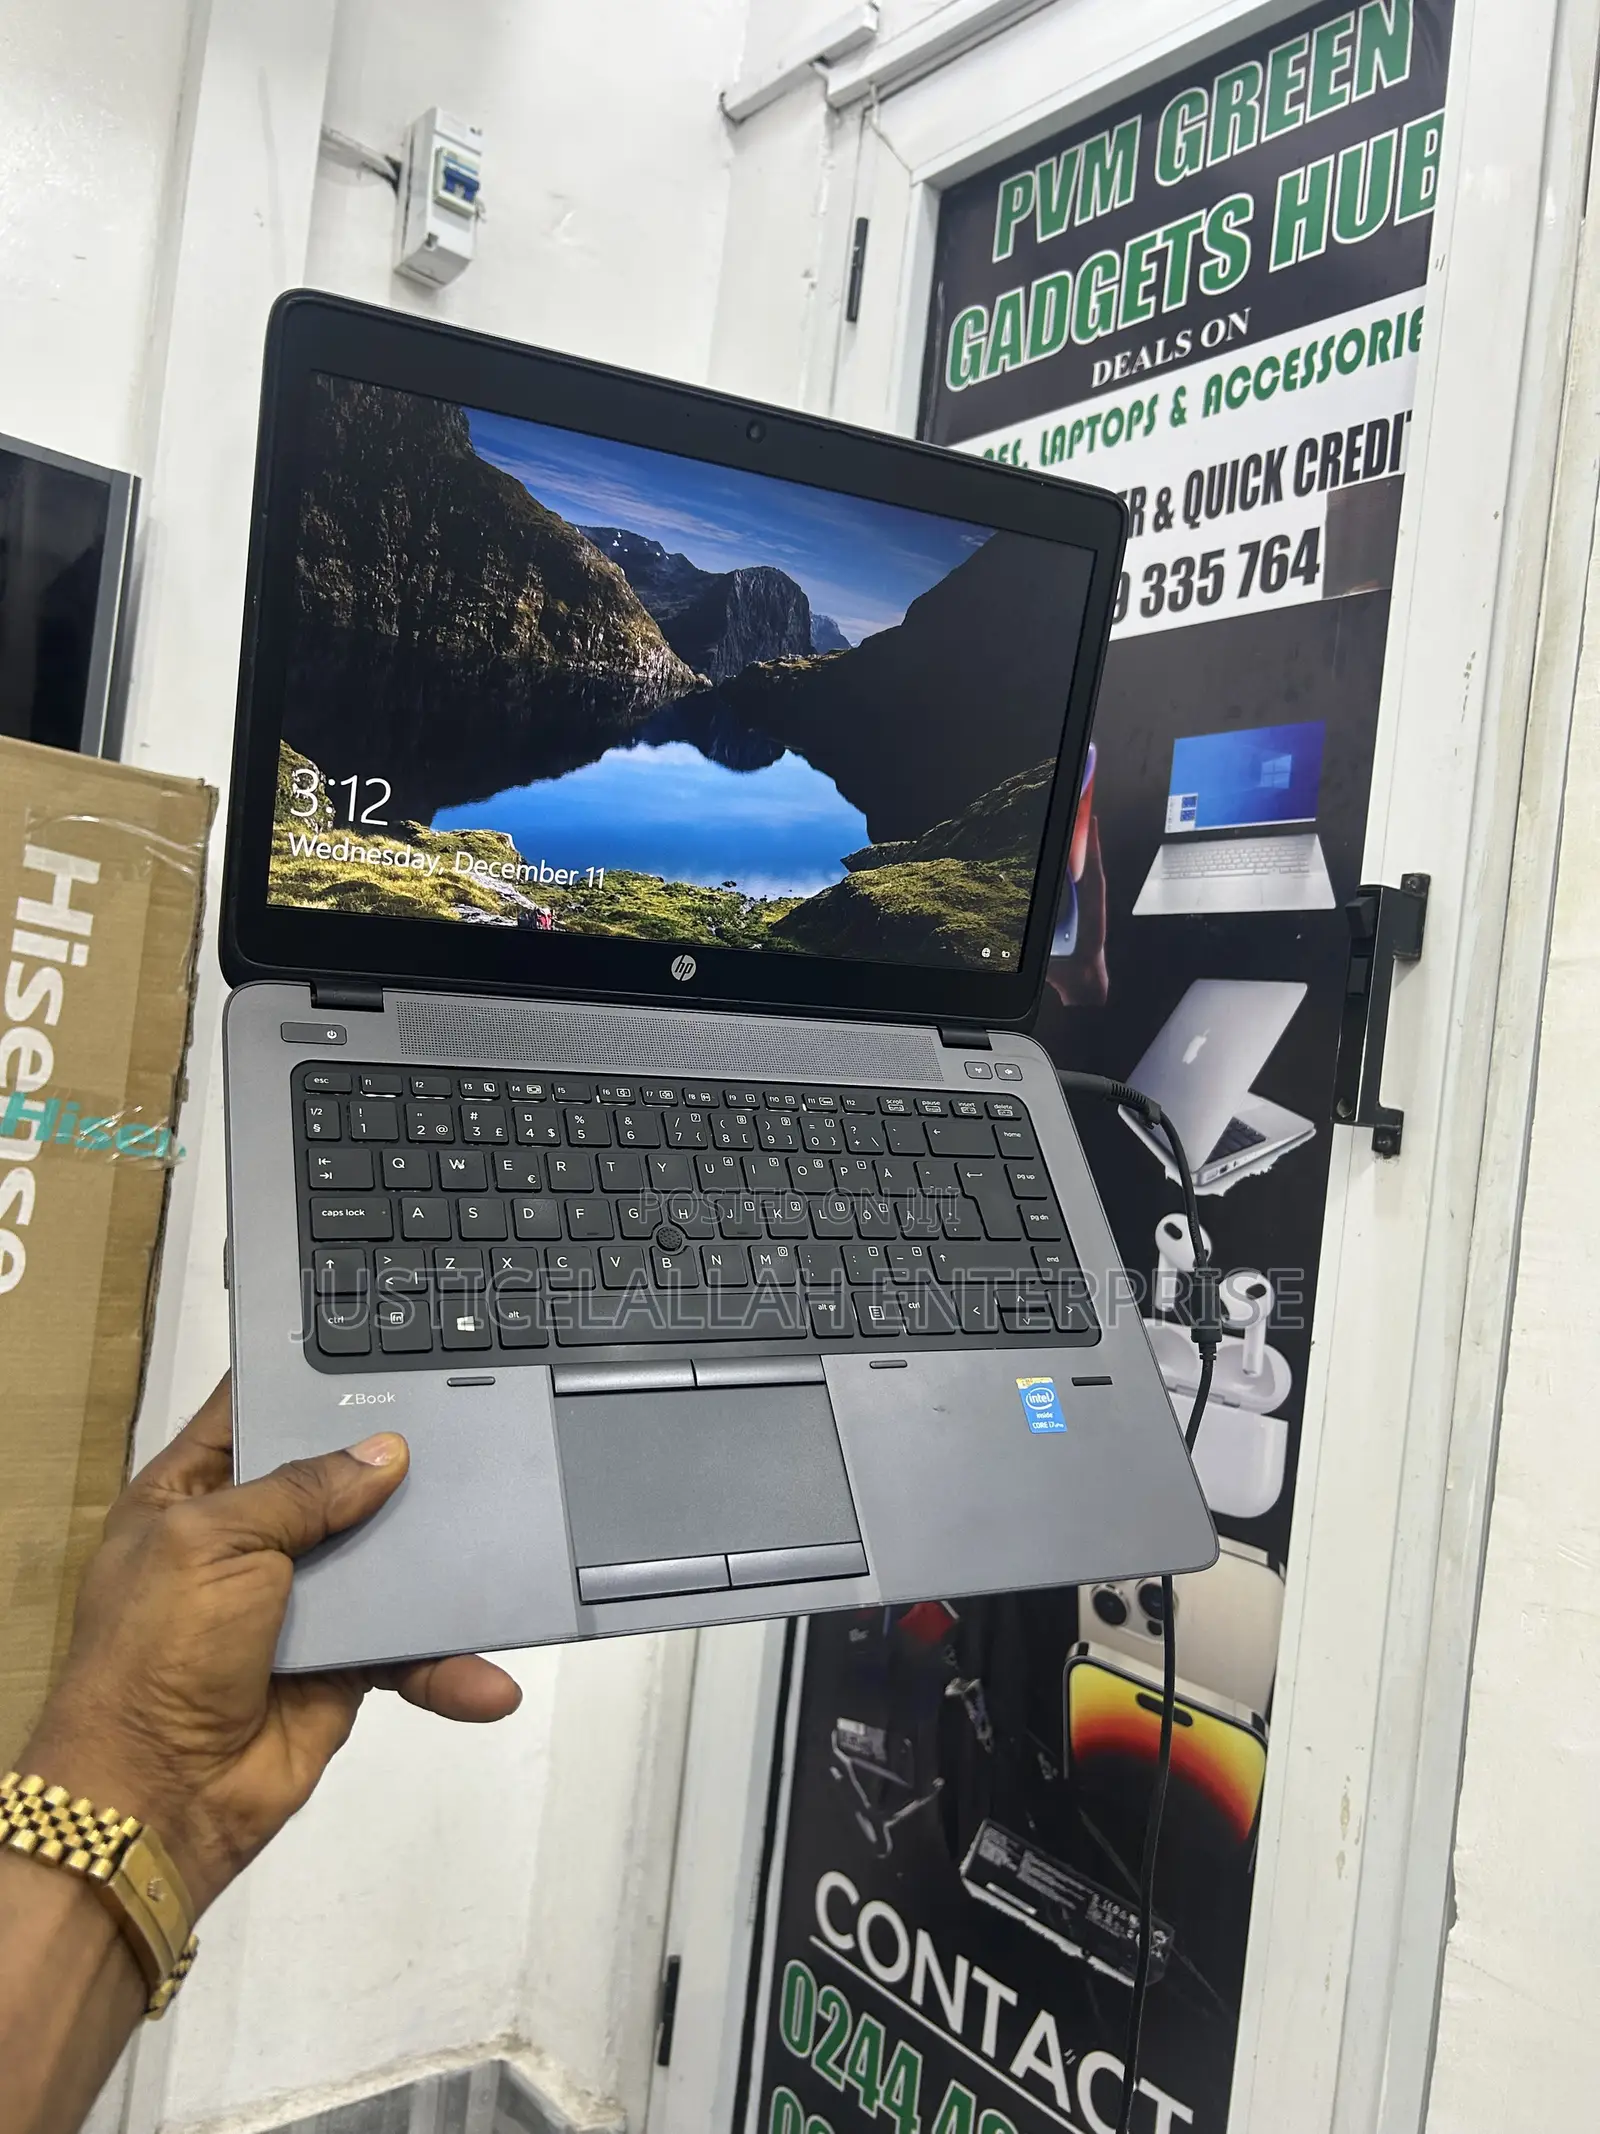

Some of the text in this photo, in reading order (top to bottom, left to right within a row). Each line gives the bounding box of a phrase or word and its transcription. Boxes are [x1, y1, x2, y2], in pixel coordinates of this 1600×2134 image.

[992, 0, 1415, 262] PVM GREEN
[944, 112, 1446, 392] GADGETS HUB
[1090, 307, 1251, 388] DEALS ON
[1039, 393, 1159, 467] LAPTOPS
[1169, 385, 1188, 428] &
[1152, 486, 1175, 533] &
[1182, 445, 1289, 530] QUICK
[1140, 548, 1226, 618] 335
[1238, 525, 1321, 601] 764
[289, 767, 392, 826] 3:12
[287, 831, 606, 889] Wednesday, December 11
[671, 954, 697, 982] hp
[364, 1078, 372, 1086] f1
[415, 1080, 425, 1089] f2
[463, 1082, 473, 1091] f3
[511, 1085, 521, 1093] f4
[557, 1086, 566, 1094] f5
[602, 1088, 611, 1096] f6
[645, 1090, 654, 1098] f7
[687, 1093, 697, 1101] f8
[728, 1093, 737, 1101] f9
[768, 1095, 780, 1103] f10
[1003, 1131, 1022, 1139] home
[391, 1157, 406, 1169] Q
[448, 1158, 466, 1170] W
[502, 1159, 514, 1171] E
[555, 1161, 567, 1172] R
[605, 1161, 616, 1172] T
[656, 1161, 668, 1173] Y
[704, 1163, 715, 1174] U
[751, 1164, 756, 1175] I
[797, 1165, 808, 1176] O
[840, 1166, 849, 1177] P
[527, 1174, 537, 1184] €
[1016, 1173, 1036, 1181] pg up
[321, 1208, 366, 1218] caps lock
[412, 1207, 425, 1219] A
[468, 1207, 478, 1219] S
[523, 1207, 535, 1219] D
[575, 1208, 585, 1219] F
[628, 1208, 640, 1219] G
[678, 1209, 689, 1220] H
[726, 1209, 734, 1219] J
[773, 1208, 784, 1219] K
[818, 1209, 828, 1220] L
[1030, 1213, 1049, 1222] pg dn
[444, 1257, 456, 1270] Z
[501, 1257, 513, 1269] X
[557, 1256, 569, 1268] C
[609, 1256, 621, 1268] V
[661, 1257, 673, 1269] B
[711, 1254, 722, 1266] N
[760, 1254, 772, 1265] M
[817, 1303, 826, 1311] alt
[908, 1301, 921, 1310] ctrl
[327, 1315, 344, 1324] ctrl
[508, 1310, 520, 1319] alt
[337, 1391, 396, 1407] ZBook
[1028, 1392, 1051, 1404] intel
[1036, 1411, 1053, 1419] inside
[1032, 1421, 1048, 1429] CORE
[815, 1871, 1194, 2134] CONTACT
[779, 1959, 923, 2134] 0244
